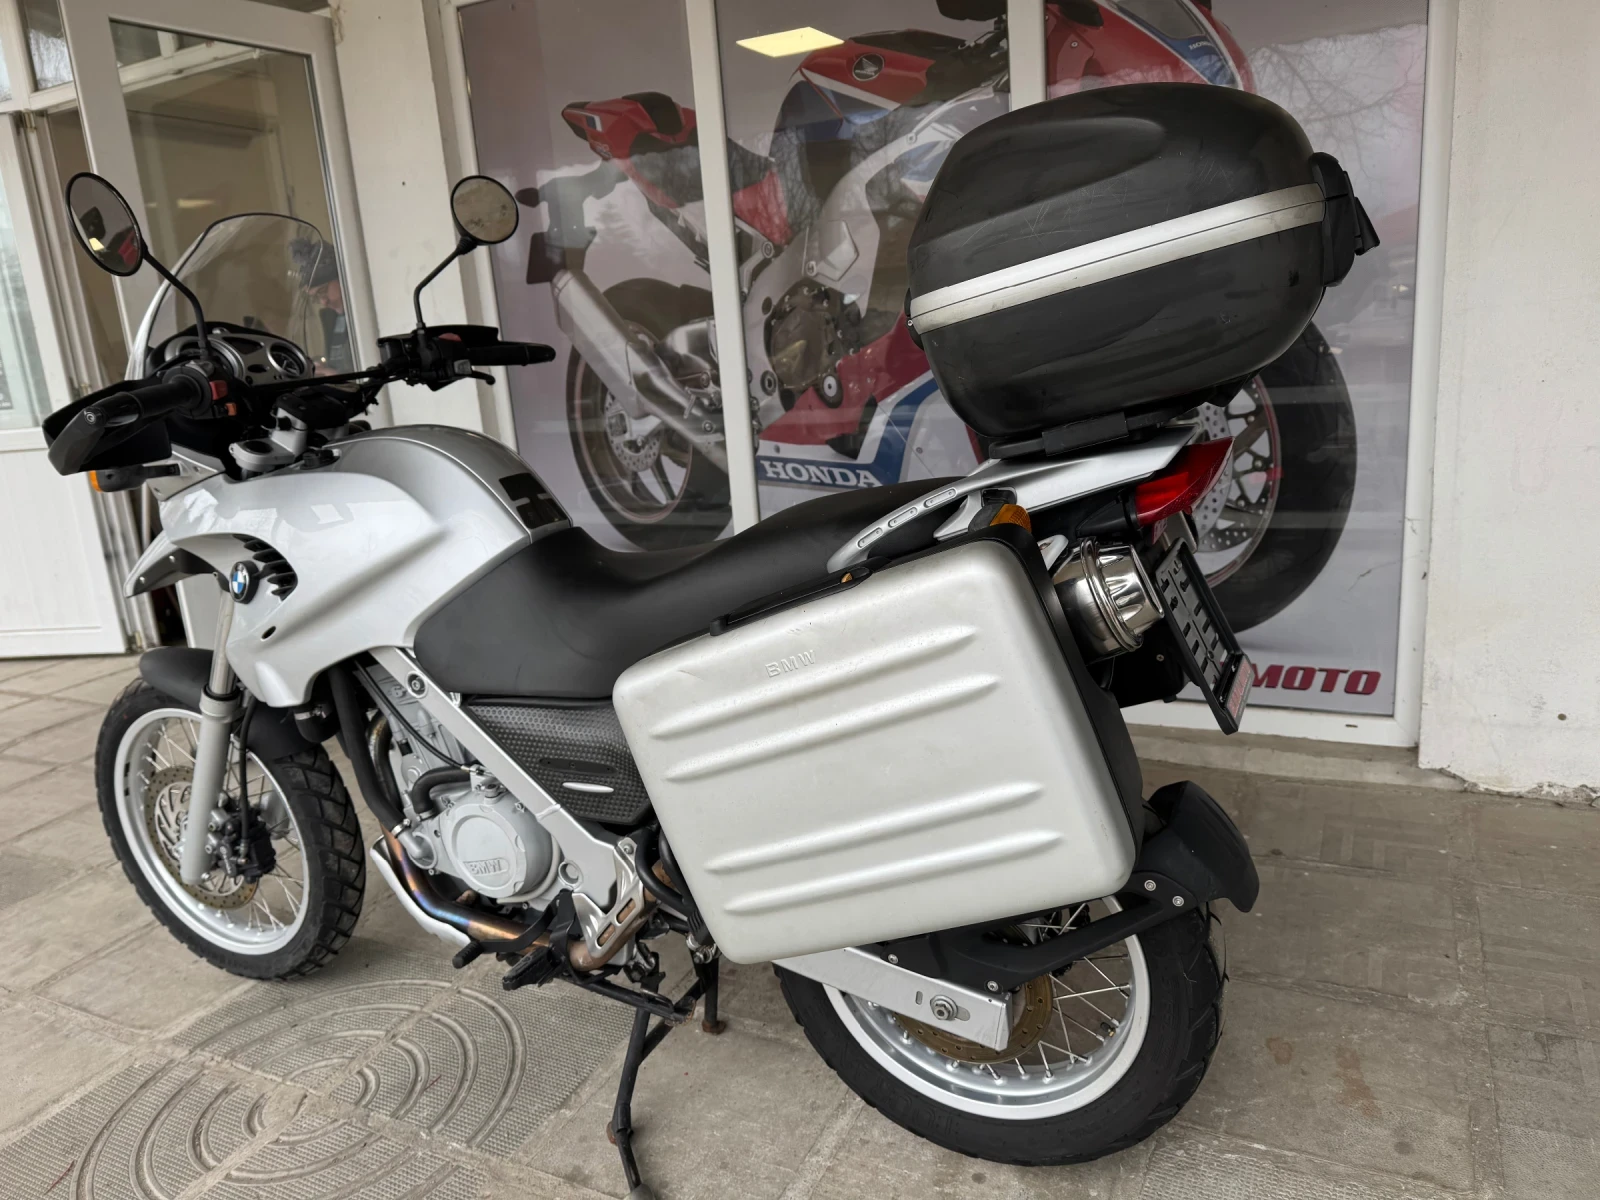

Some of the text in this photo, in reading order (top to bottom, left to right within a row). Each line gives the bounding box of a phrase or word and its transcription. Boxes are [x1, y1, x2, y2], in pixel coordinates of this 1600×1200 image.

[760, 460, 883, 488] HONDA
[765, 649, 816, 678] BMW
[467, 859, 502, 876] BMW
